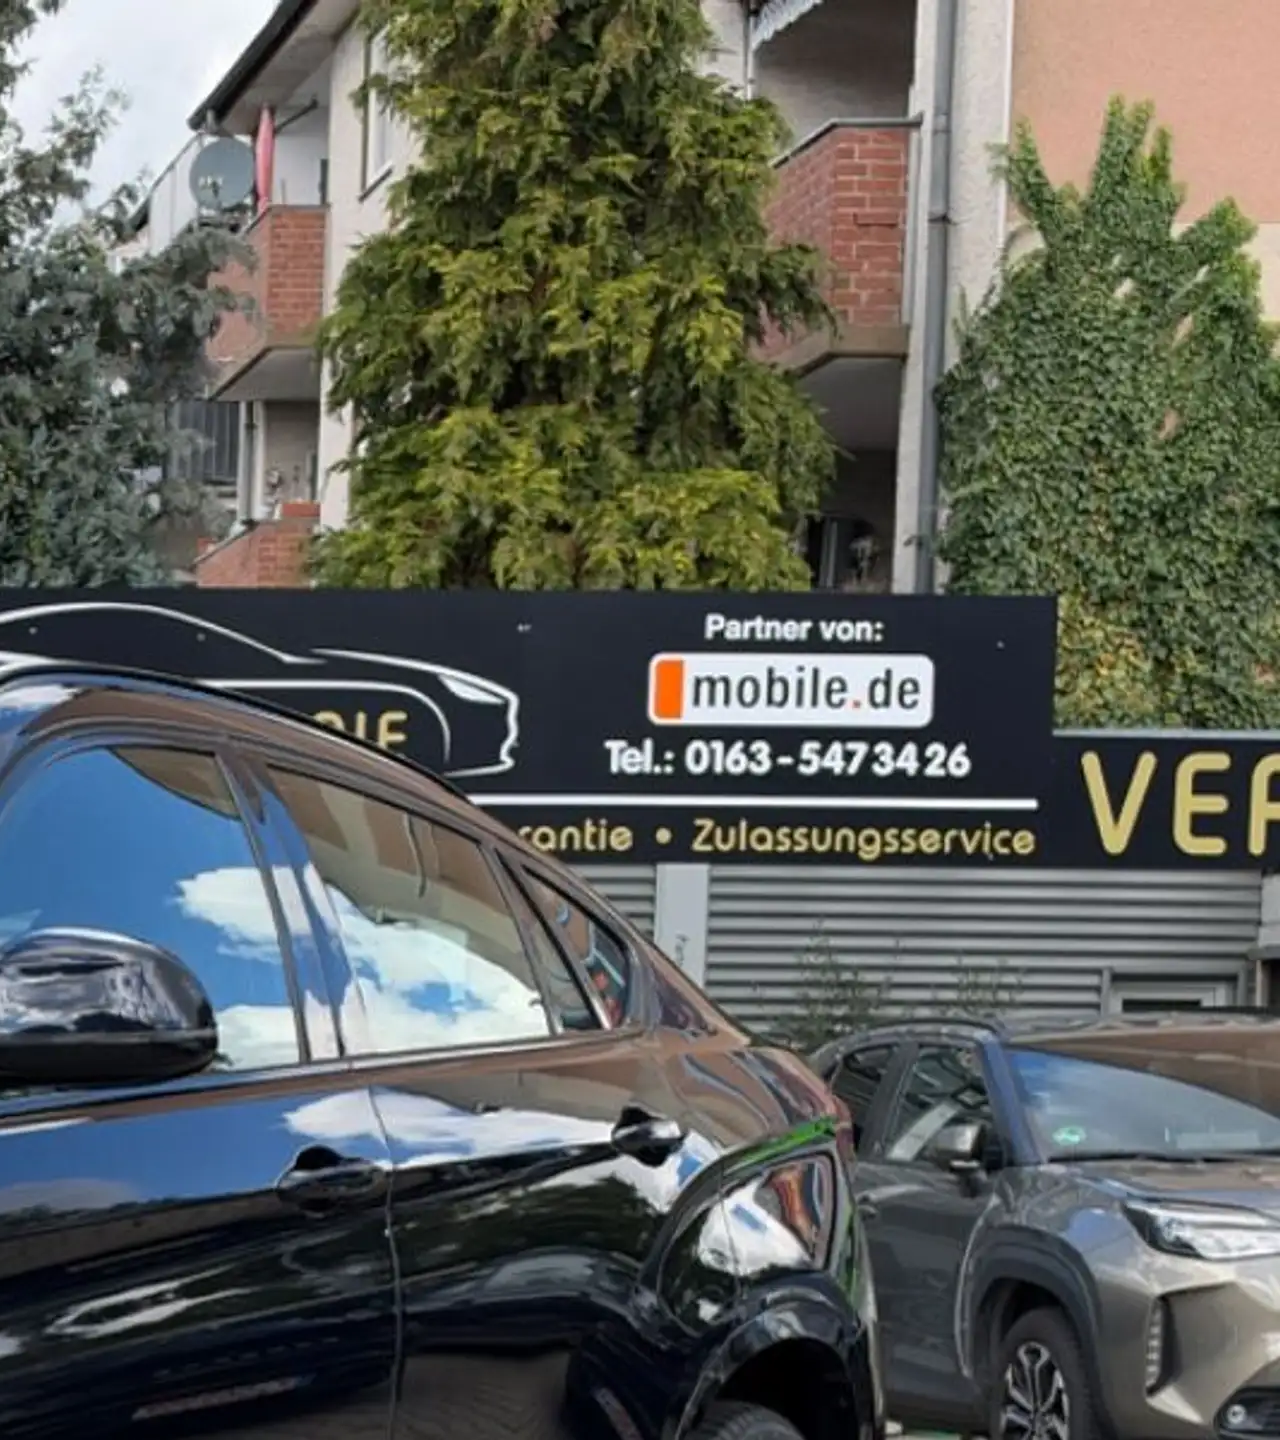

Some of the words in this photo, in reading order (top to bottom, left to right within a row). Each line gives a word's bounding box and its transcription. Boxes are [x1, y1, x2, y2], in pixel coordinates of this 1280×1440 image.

[704, 613, 813, 642] Partner
[819, 618, 885, 643] von:
[692, 665, 922, 711] mobile.de
[604, 737, 676, 776] Tel.:
[691, 817, 1037, 862] Zulassungsservice
